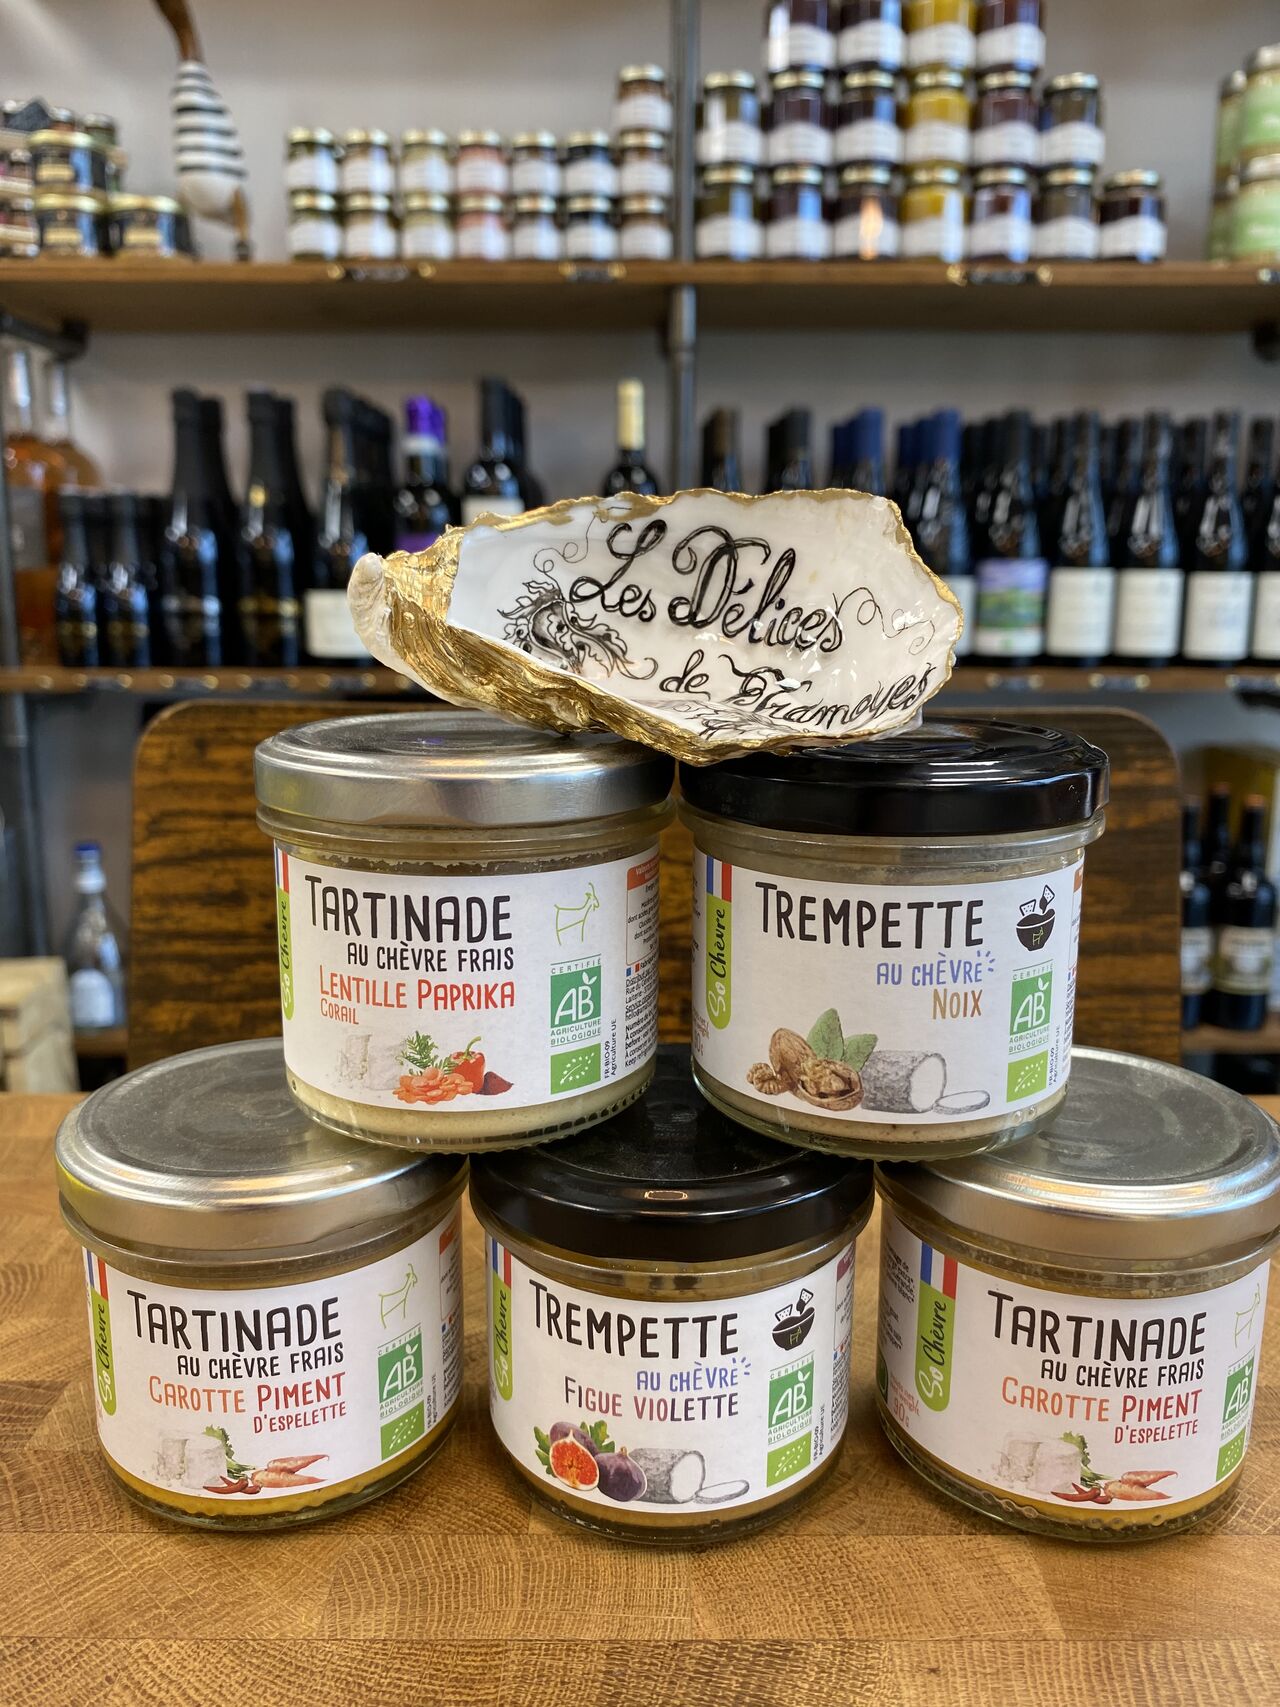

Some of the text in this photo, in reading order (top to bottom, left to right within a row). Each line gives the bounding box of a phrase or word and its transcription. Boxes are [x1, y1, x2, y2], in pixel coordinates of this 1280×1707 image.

[570, 519, 843, 653] Les Délices
[660, 650, 710, 700] de
[305, 875, 513, 943] TARTINADE
[755, 881, 984, 950] TREMPETTE
[347, 941, 514, 972] AU CHÈVRE FRAIS
[877, 952, 982, 986] AU CHÈVRE
[281, 973, 291, 1009] So
[320, 965, 515, 1011] LENTILLE PAPRIKA
[555, 985, 594, 1025] AB
[708, 981, 726, 1017] So
[932, 988, 982, 1020] NOIX
[321, 1003, 359, 1024] CORAIL
[551, 1019, 601, 1036] AGRICULTURE
[1013, 991, 1046, 1033] AB
[551, 1027, 601, 1045] BIOLOGIQUE
[1009, 1026, 1049, 1043] AGRICULTURE
[1009, 1035, 1049, 1053] BIOLOGIQUE
[127, 1289, 342, 1353] TARTINADE
[529, 1279, 739, 1359] TREMPETTE
[988, 1290, 1207, 1362] TARTINADE
[177, 1342, 344, 1379] AU CHÈVRE FRAIS
[383, 1355, 417, 1399] AB
[495, 1354, 508, 1387] So
[637, 1361, 738, 1391] AU CHÈVRE
[1041, 1359, 1067, 1382] AU
[1076, 1361, 1148, 1388] CHÈVRE
[1157, 1358, 1204, 1386] FRAIS
[98, 1369, 112, 1403] So
[149, 1375, 246, 1414] CAROTTE
[257, 1371, 346, 1411] PIMENT
[380, 1381, 424, 1411] AGRICULTURE
[565, 1375, 739, 1422] FIGUE VIOLETTE
[918, 1365, 944, 1398] So
[1002, 1375, 1202, 1423] CAROTTE PIMENT
[1225, 1377, 1249, 1421] AB
[253, 1402, 347, 1434] D'ESPELETTE
[380, 1387, 424, 1418] BIOLOGIQUE
[771, 1382, 807, 1425] AB
[768, 1409, 812, 1435] AGRICULTURE
[768, 1416, 812, 1443] BIOLOGIQUE
[1114, 1420, 1198, 1445] D'ESPELETTE
